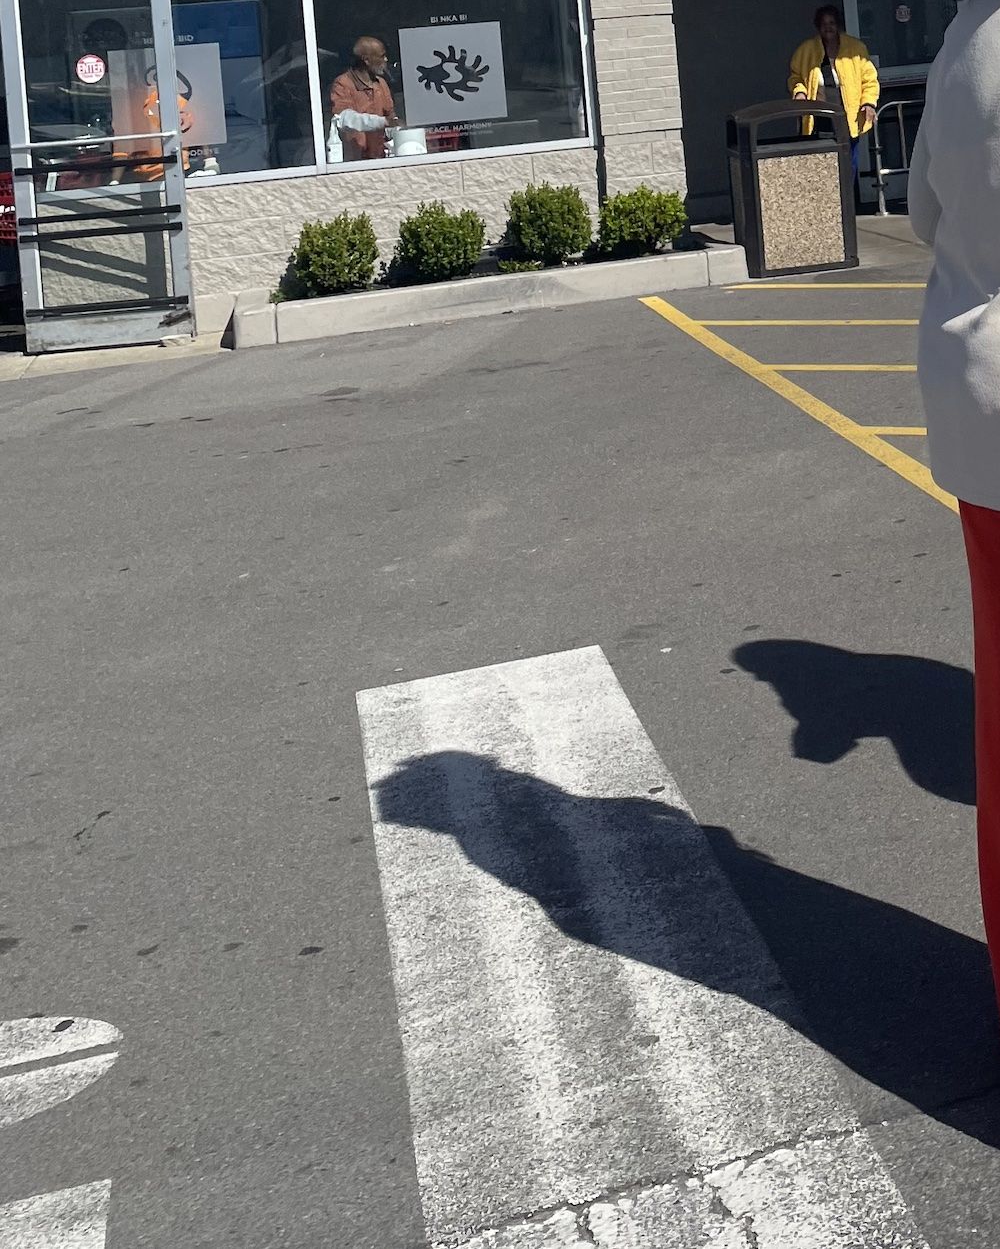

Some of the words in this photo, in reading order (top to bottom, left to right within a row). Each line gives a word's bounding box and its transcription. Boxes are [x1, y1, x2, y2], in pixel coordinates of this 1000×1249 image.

[430, 16, 439, 24] BI
[440, 14, 458, 22] NKA
[79, 62, 103, 74] ENTER
[452, 122, 492, 132] HARMONY
